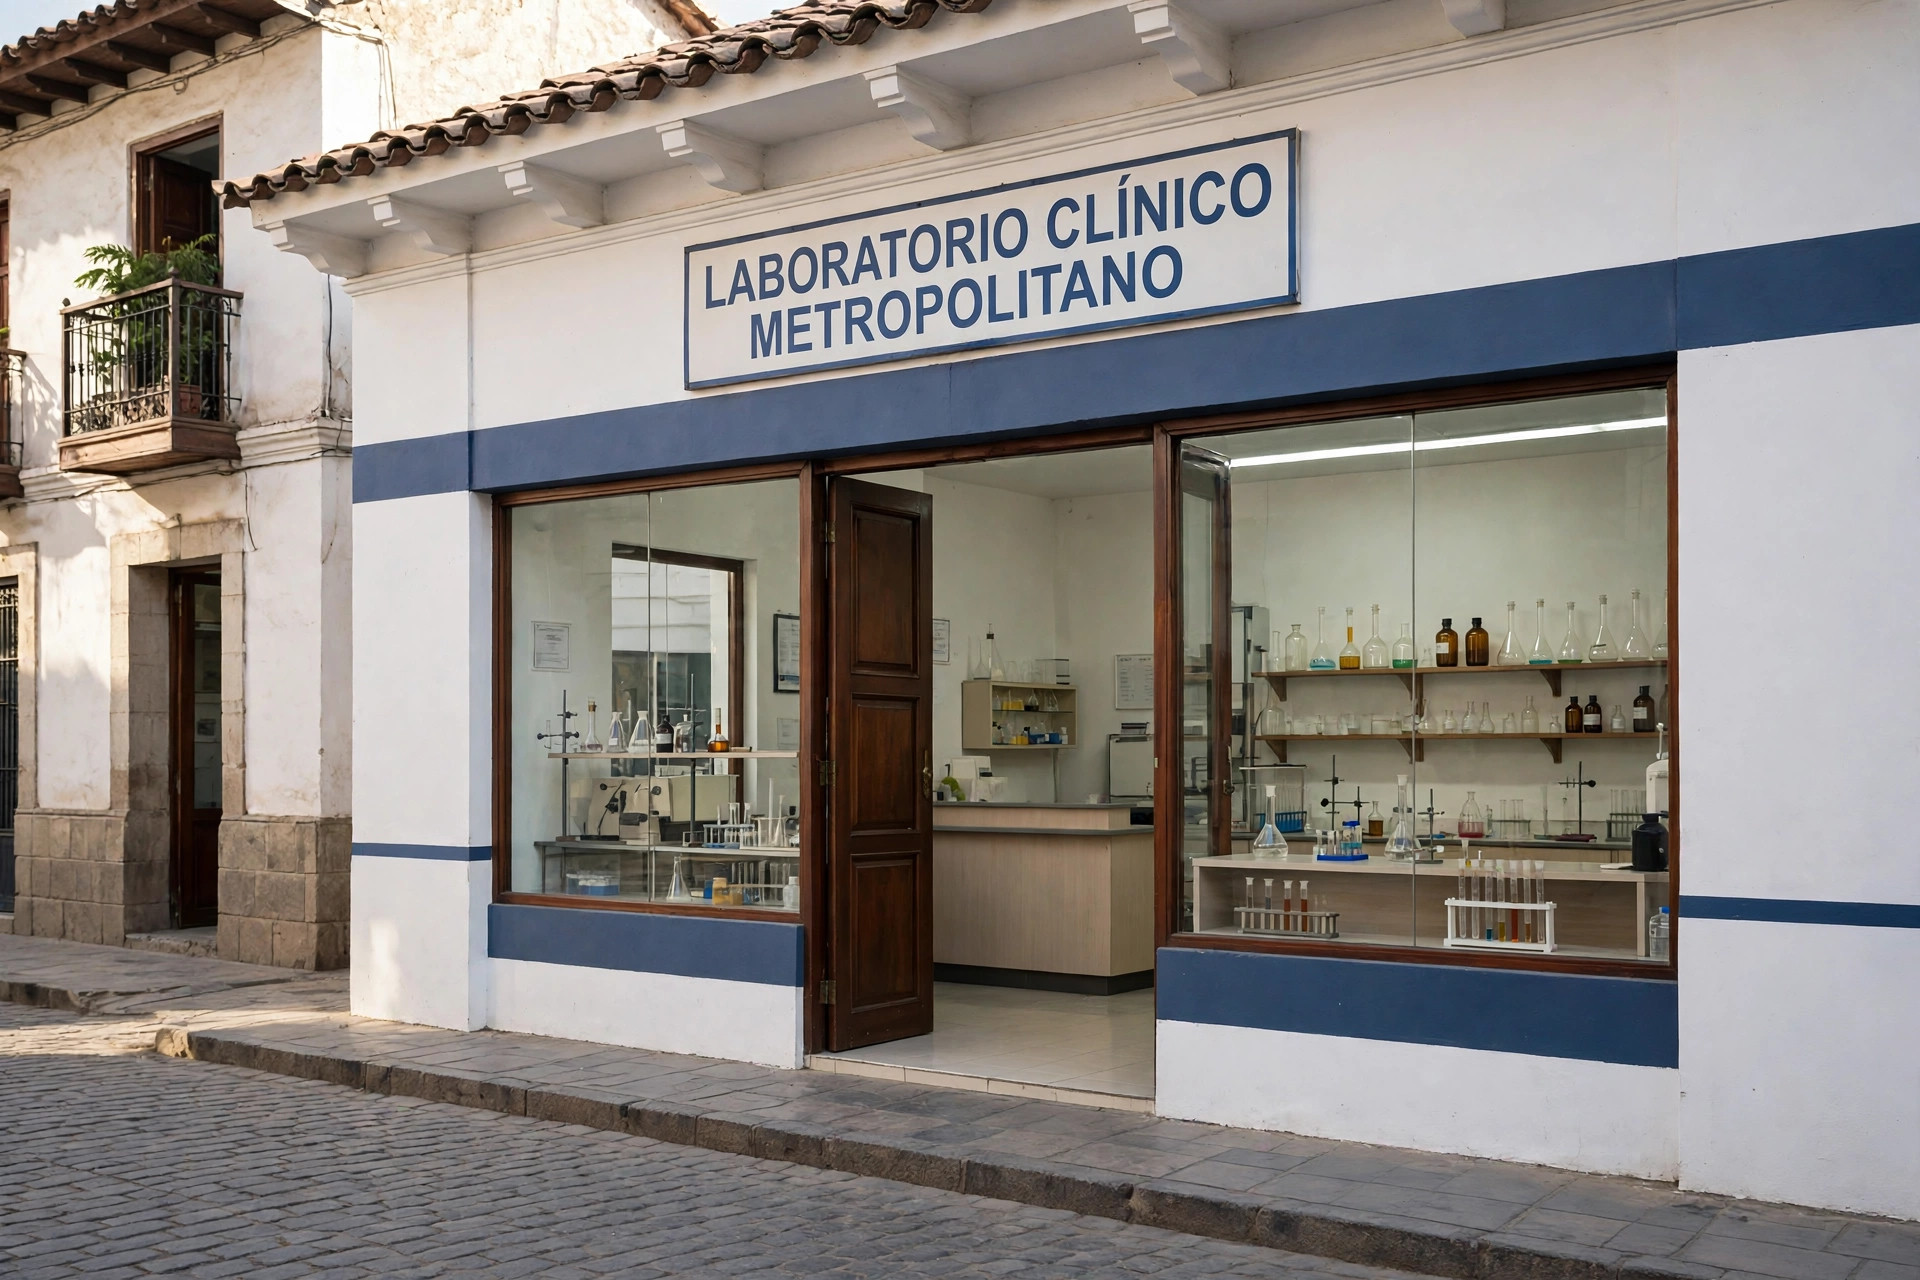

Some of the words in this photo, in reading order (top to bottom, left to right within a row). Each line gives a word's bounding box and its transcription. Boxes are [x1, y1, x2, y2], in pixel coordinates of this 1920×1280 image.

[705, 208, 1029, 309] LABORATORIO
[1046, 162, 1272, 250] CLÍNICO
[750, 245, 1183, 359] METROPOLITANO
